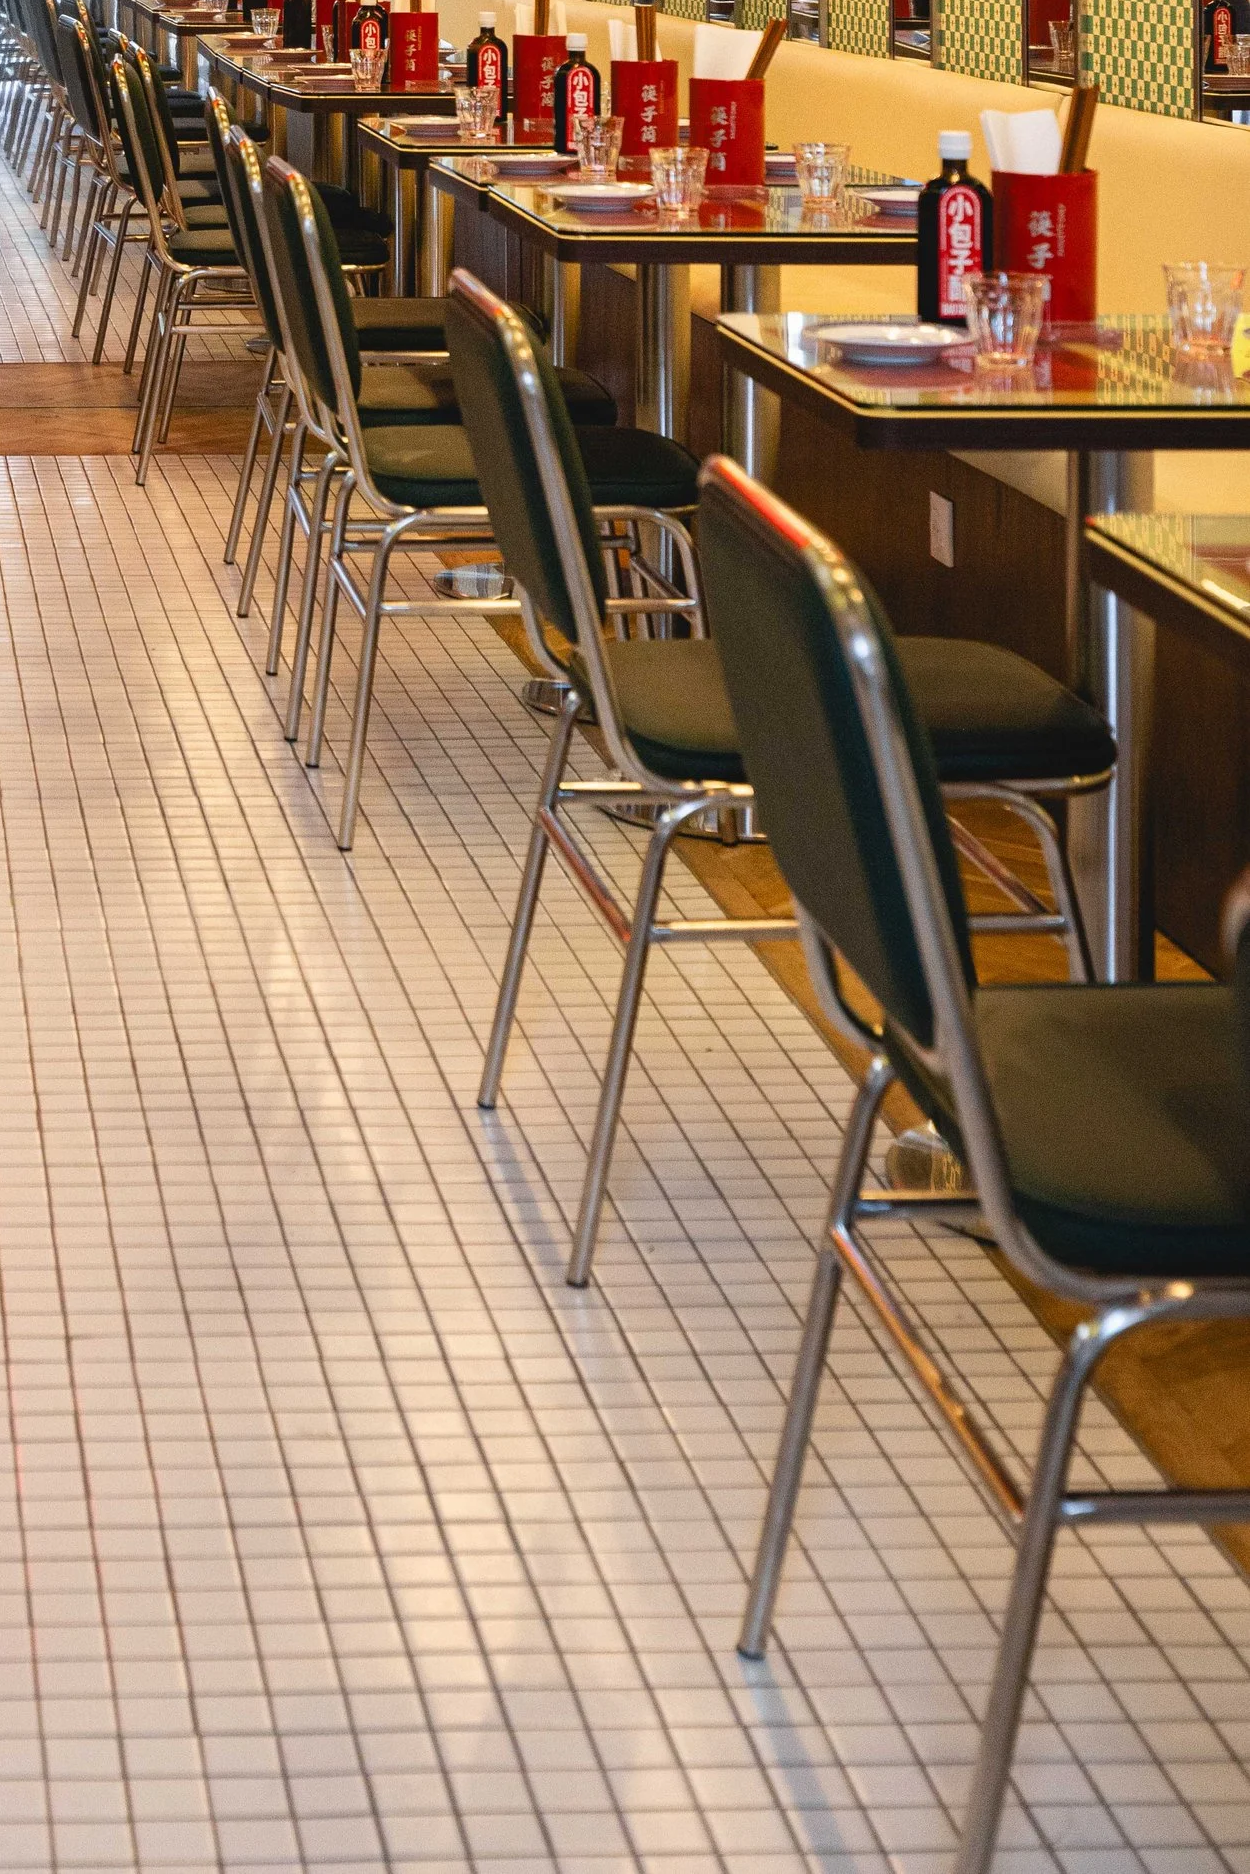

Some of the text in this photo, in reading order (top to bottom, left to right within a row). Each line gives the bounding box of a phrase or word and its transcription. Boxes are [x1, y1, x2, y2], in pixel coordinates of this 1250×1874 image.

[364, 23, 377, 49] 小包
[482, 48, 498, 89] 小包子
[572, 71, 590, 117] 小包子
[1026, 209, 1056, 286] 筷子
